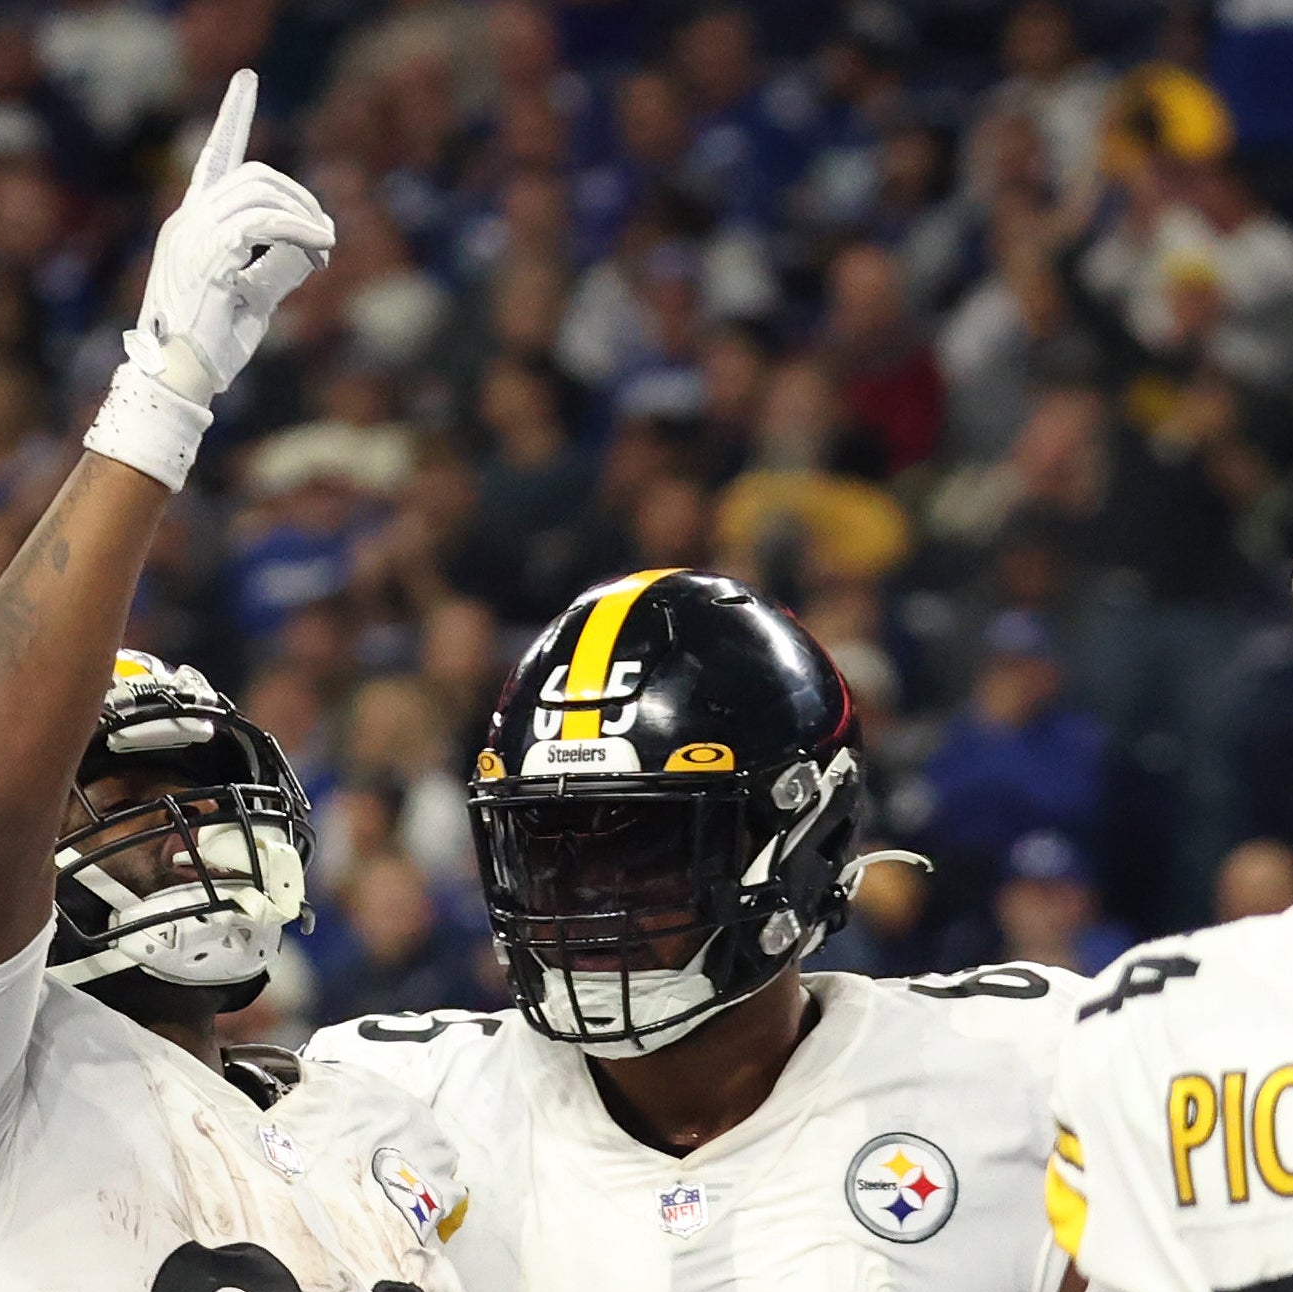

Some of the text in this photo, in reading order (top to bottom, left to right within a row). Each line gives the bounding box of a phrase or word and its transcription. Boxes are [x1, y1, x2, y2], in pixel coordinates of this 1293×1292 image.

[533, 660, 643, 740] 65
[547, 743, 606, 764] Steelers
[856, 1179, 898, 1191] Steelers
